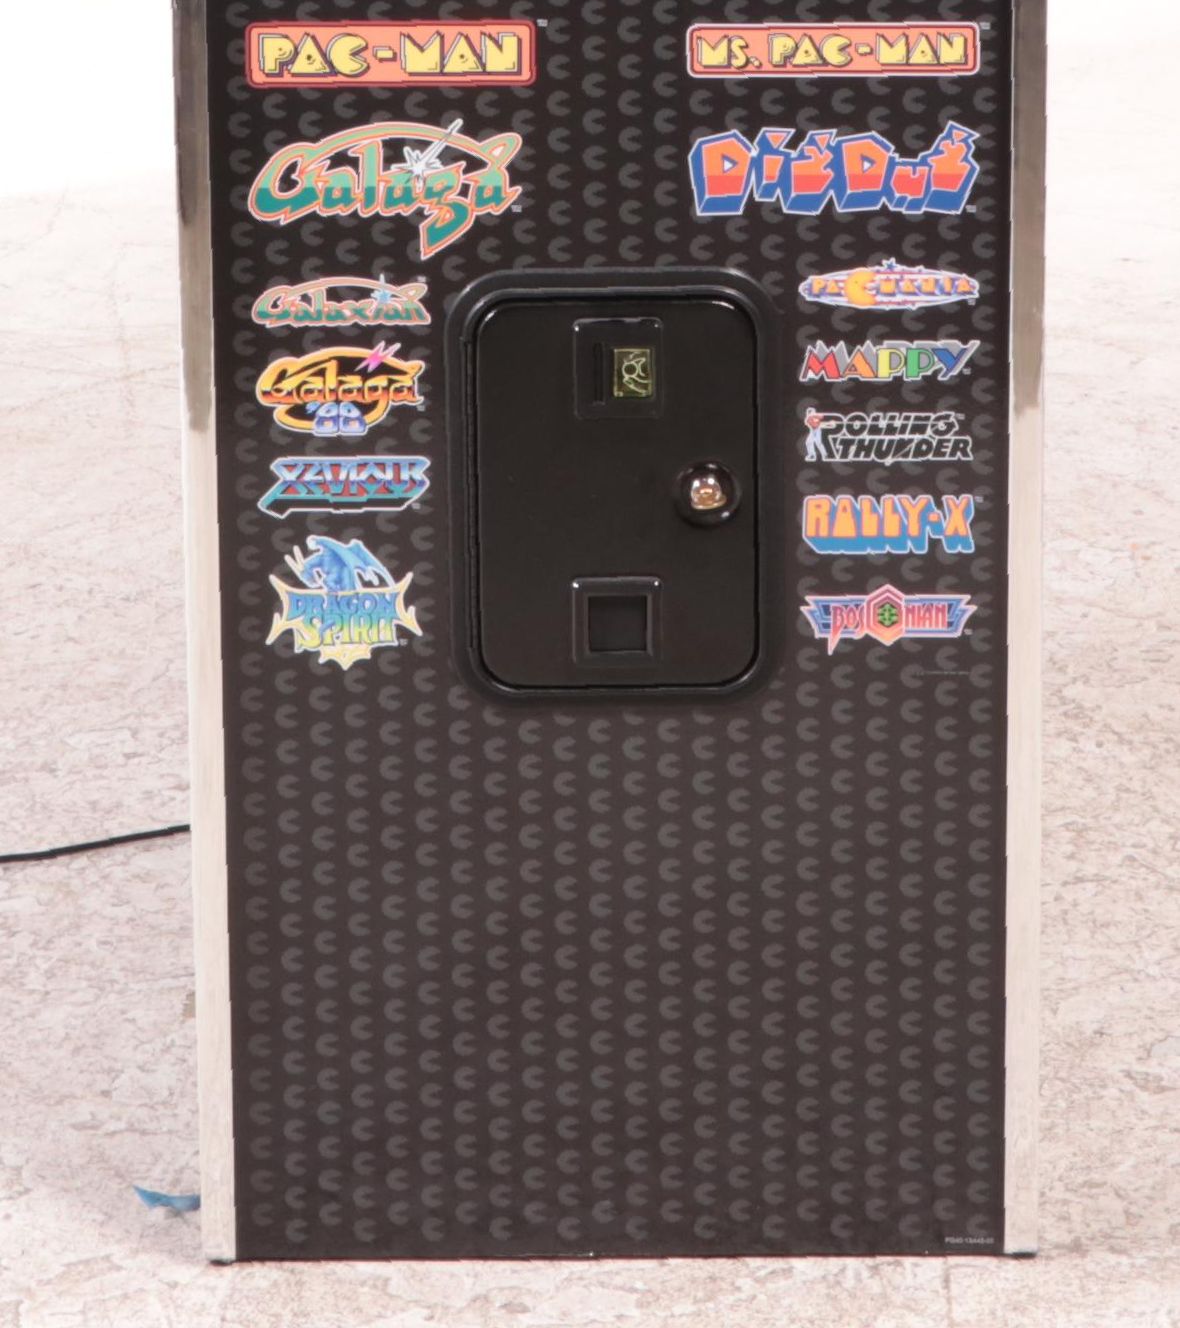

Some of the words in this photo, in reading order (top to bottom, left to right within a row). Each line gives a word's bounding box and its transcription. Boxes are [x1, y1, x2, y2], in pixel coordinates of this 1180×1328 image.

[257, 31, 523, 77] PAC-MAN
[697, 33, 762, 68] MS.
[768, 32, 969, 68] PAC-MAN
[248, 121, 522, 261] Galaga
[252, 276, 431, 327] Galaxian
[257, 347, 424, 414] Galaga
[801, 341, 978, 381] MAPPY
[837, 435, 973, 461] THUNDER
[803, 494, 975, 555] RALLY-X
[288, 591, 399, 621] DRAGON
[298, 616, 398, 649] SPIRIT
